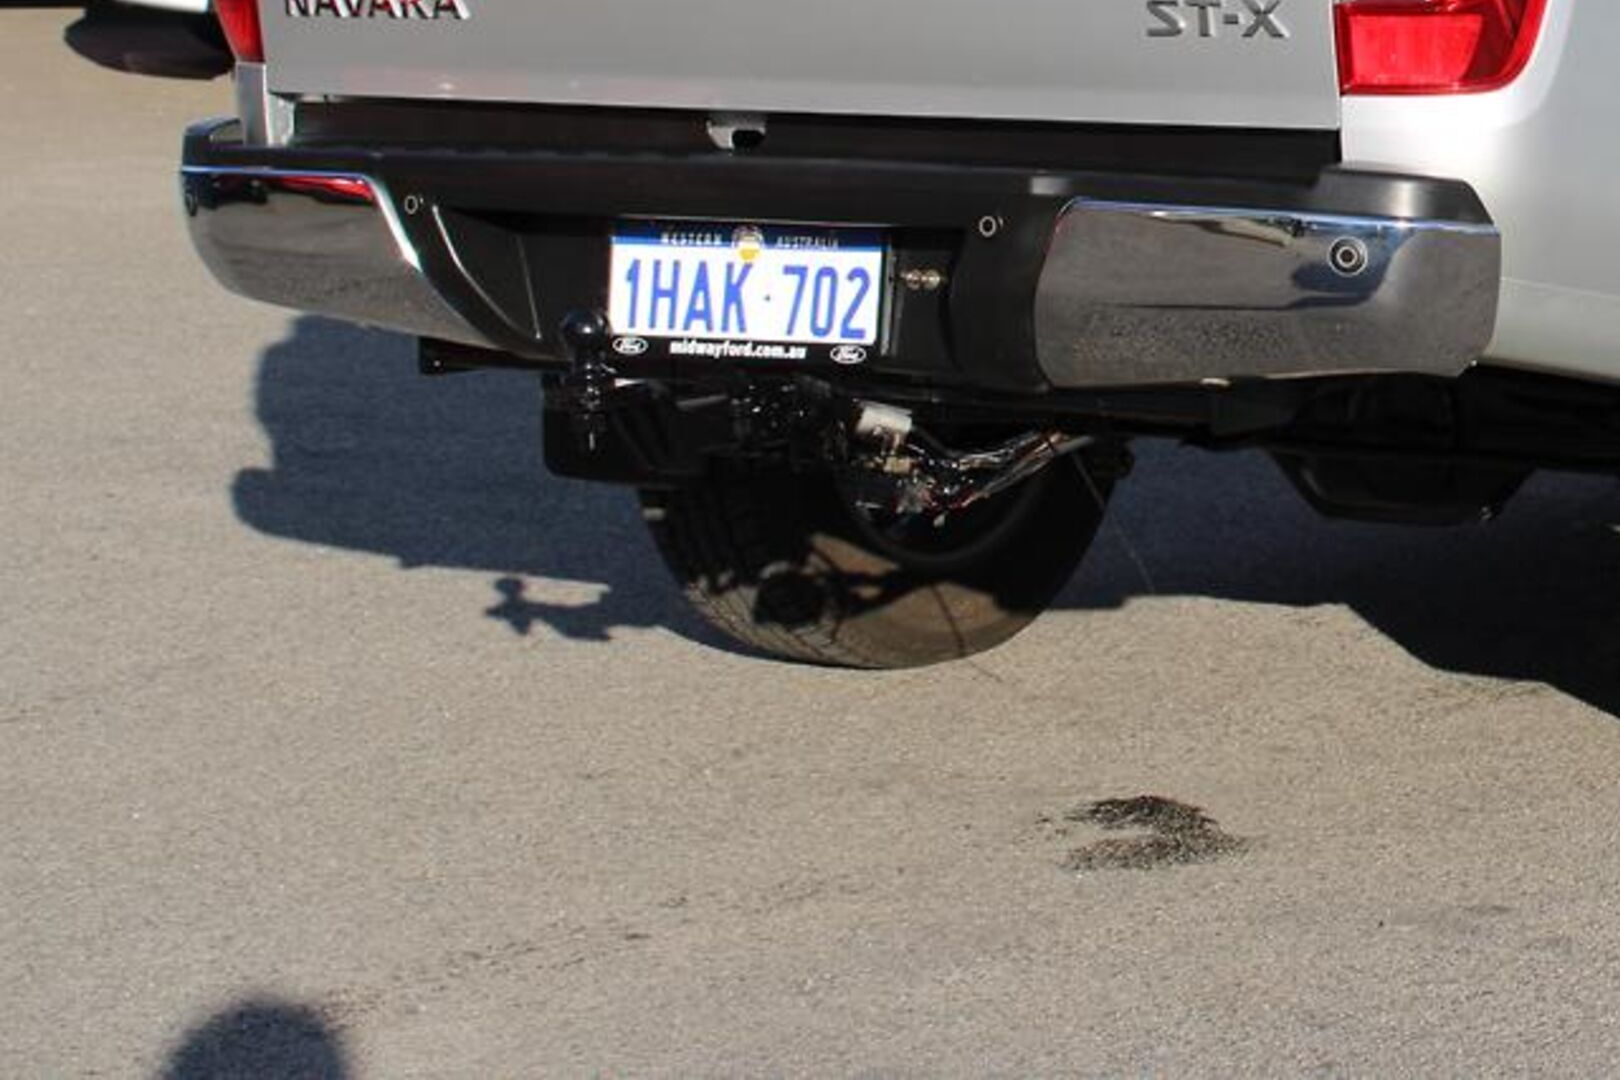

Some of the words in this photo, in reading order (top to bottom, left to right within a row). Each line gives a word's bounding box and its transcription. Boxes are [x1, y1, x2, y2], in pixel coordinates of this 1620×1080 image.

[626, 259, 753, 333] 1HAK
[782, 264, 872, 340] 702
[669, 340, 807, 359] midwayford.com.au
